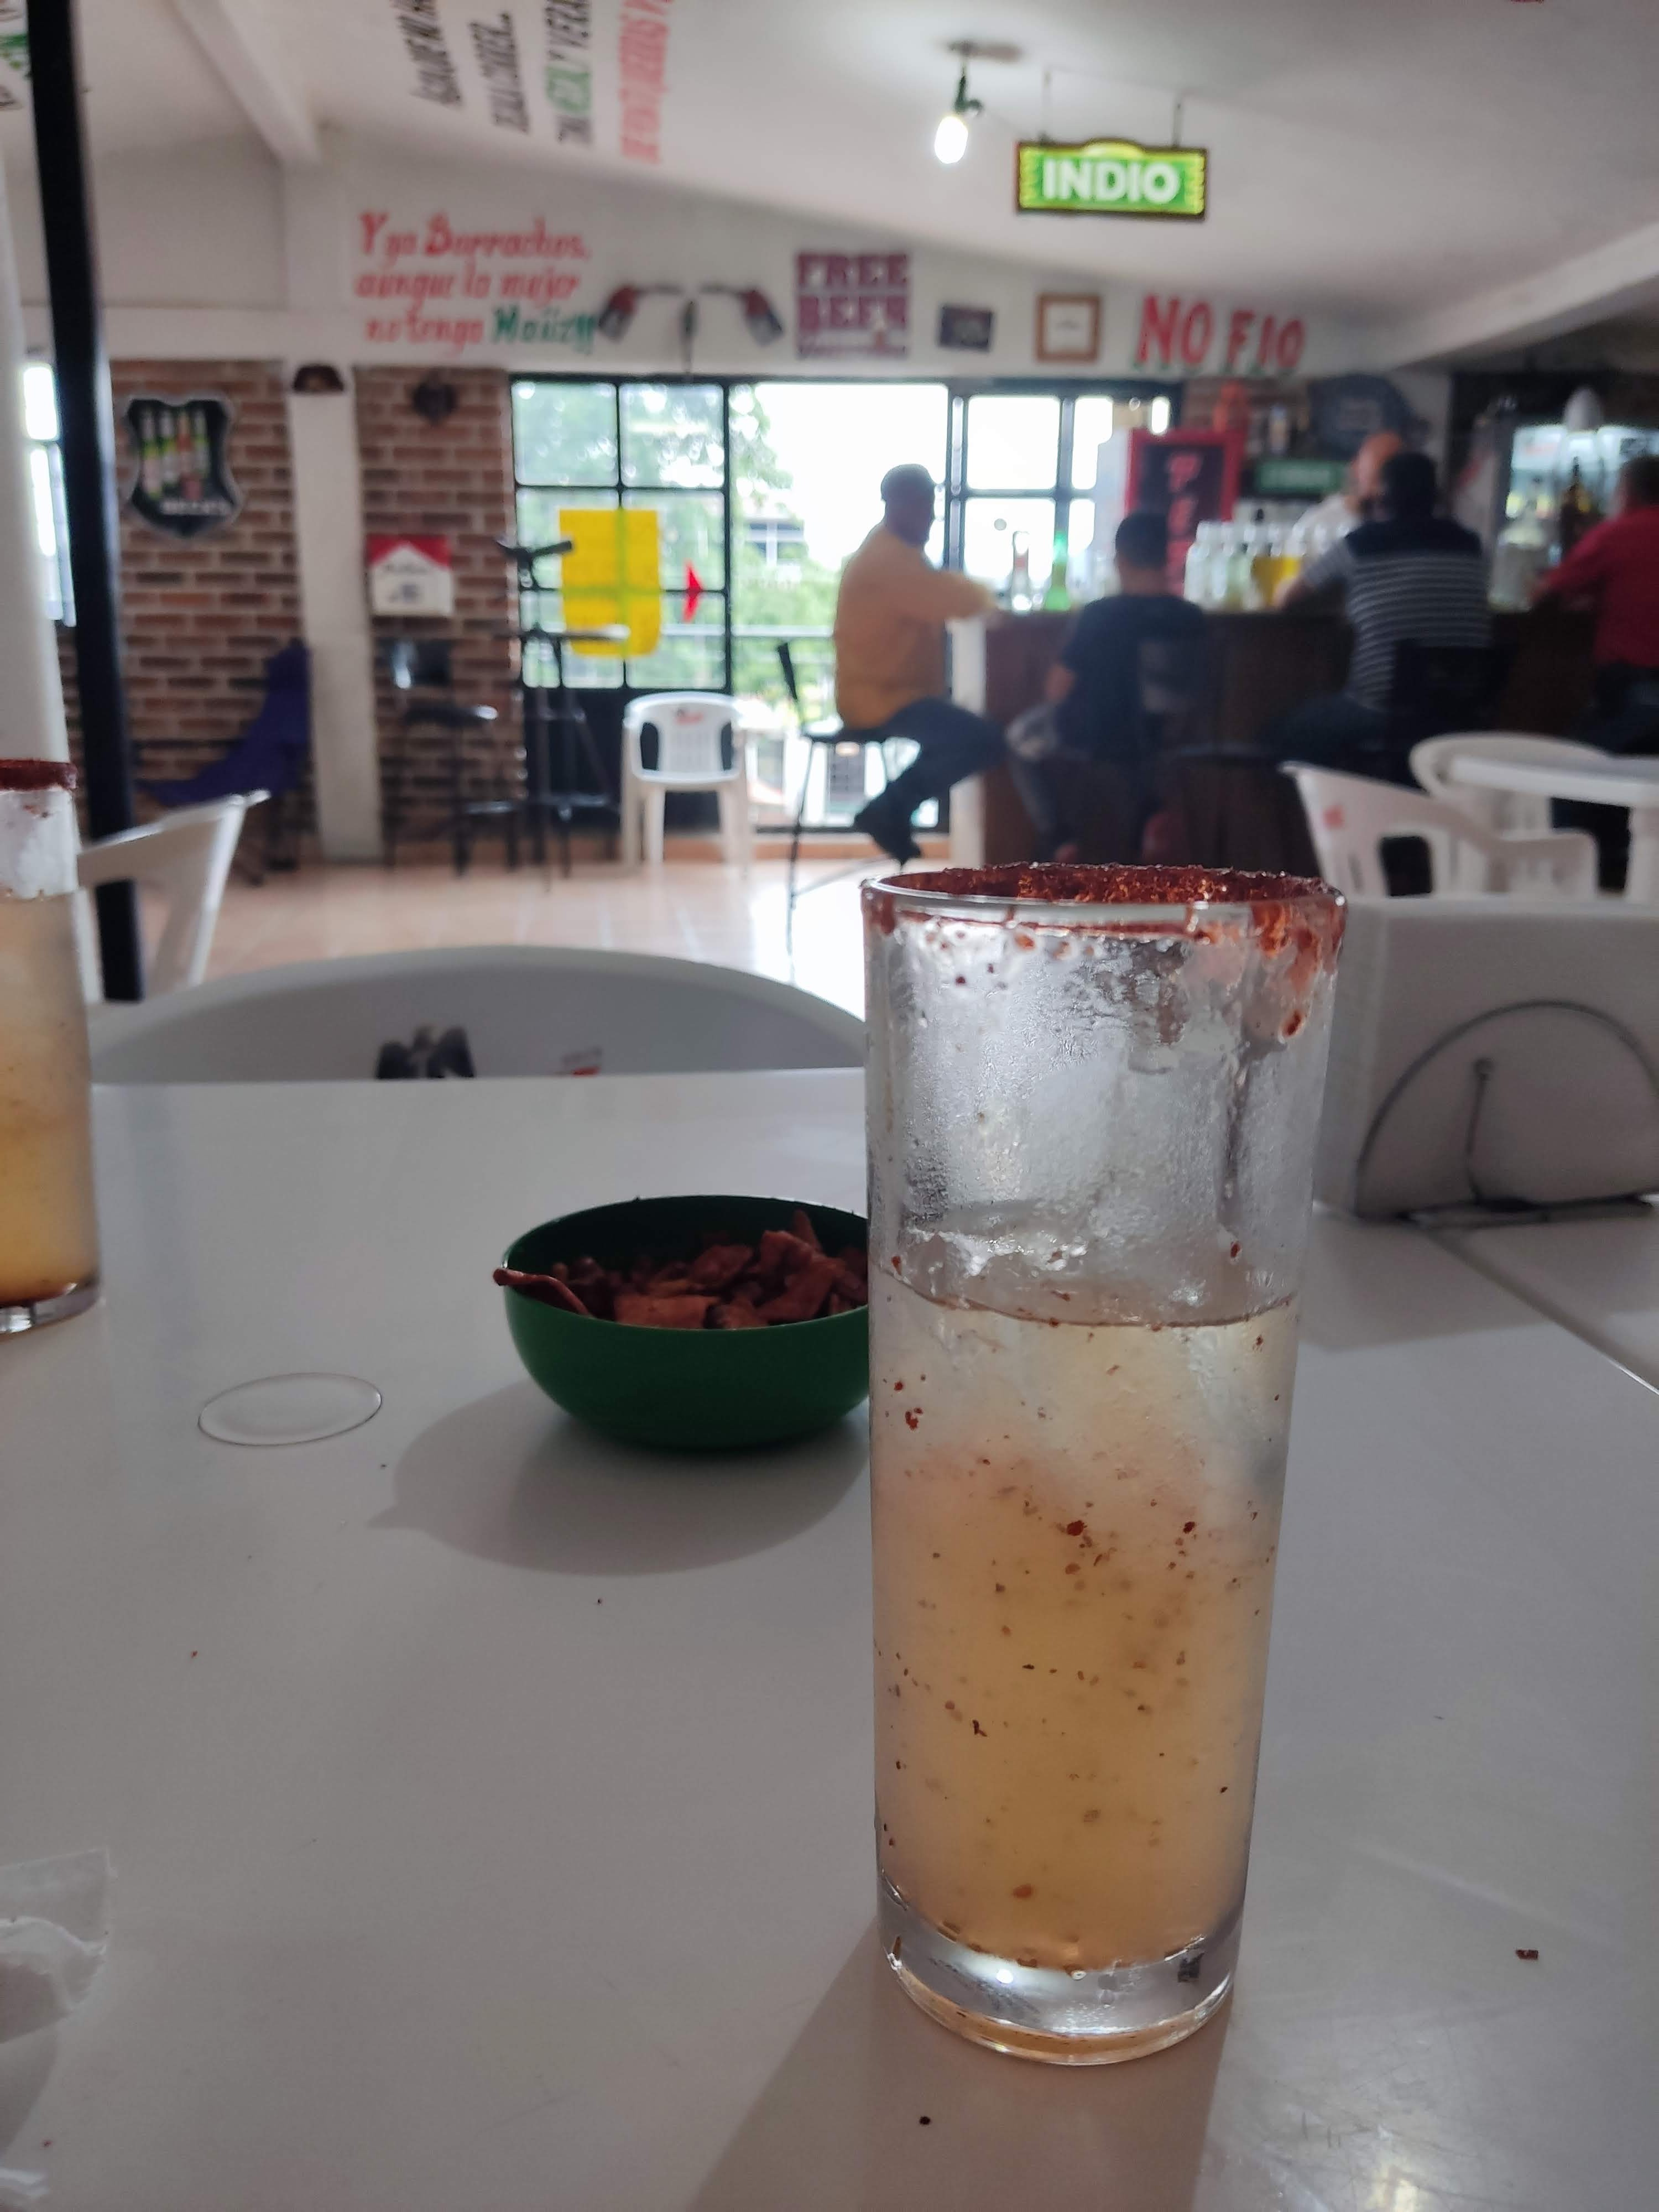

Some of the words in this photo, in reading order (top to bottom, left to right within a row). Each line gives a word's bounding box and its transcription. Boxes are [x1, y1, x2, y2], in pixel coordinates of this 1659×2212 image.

[1042, 158, 1181, 204] INDIO
[796, 253, 910, 287] FREE
[1134, 295, 1213, 372] NO
[1223, 310, 1306, 376] FIO
